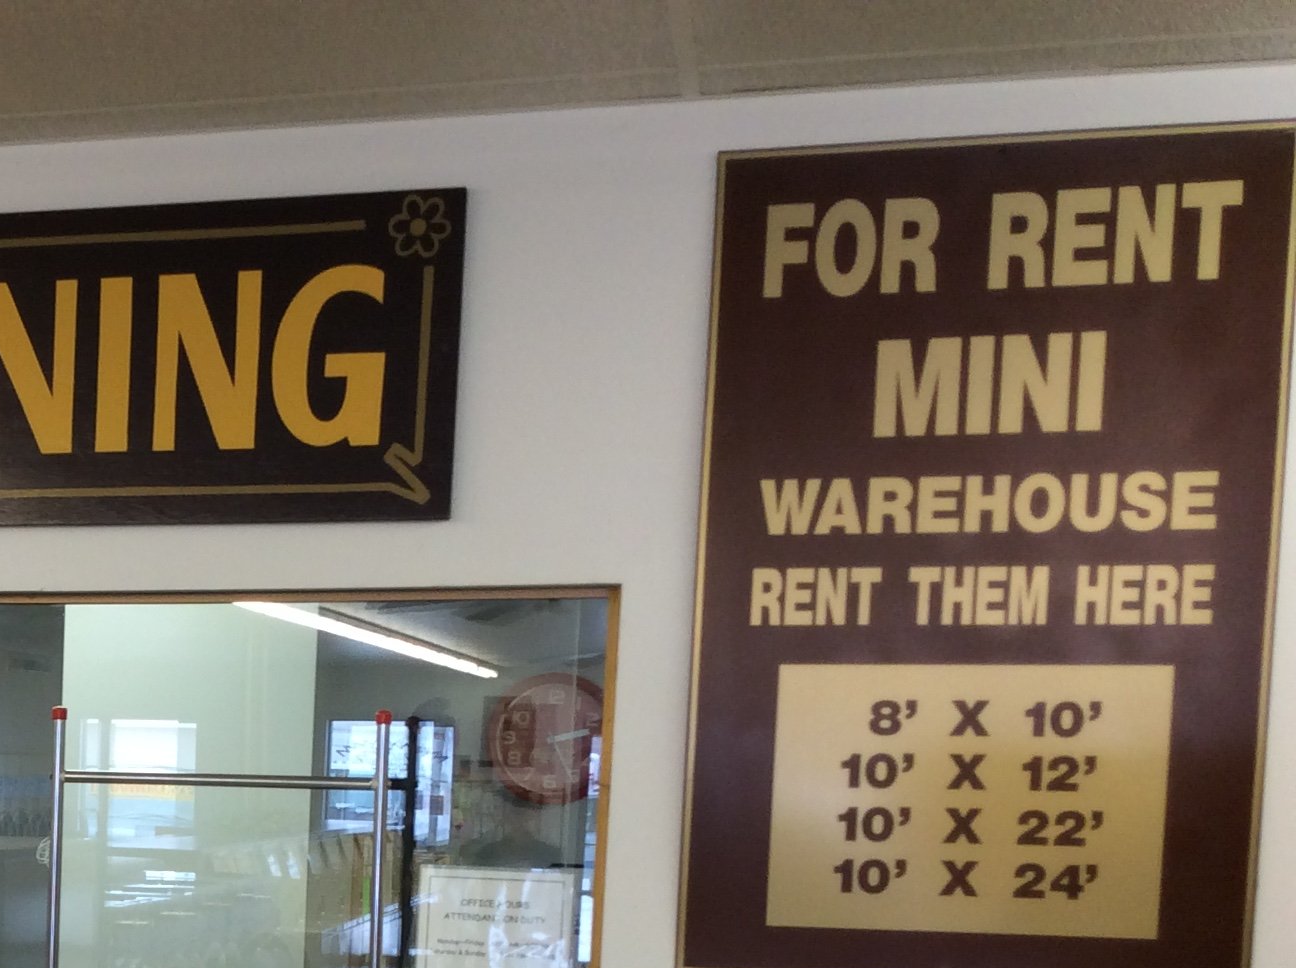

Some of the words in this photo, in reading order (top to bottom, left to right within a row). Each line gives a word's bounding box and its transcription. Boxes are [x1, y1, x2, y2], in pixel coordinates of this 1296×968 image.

[762, 197, 941, 300] FOR
[987, 179, 1245, 291] RENT
[872, 330, 1108, 438] MINI
[758, 470, 1221, 536] WAREHOUSE
[749, 566, 882, 627] RENT
[908, 565, 1050, 627] THEM
[1074, 564, 1216, 626] HERE
[949, 700, 990, 737] X
[946, 754, 987, 791] X
[942, 807, 983, 844] X
[938, 859, 979, 896] X
